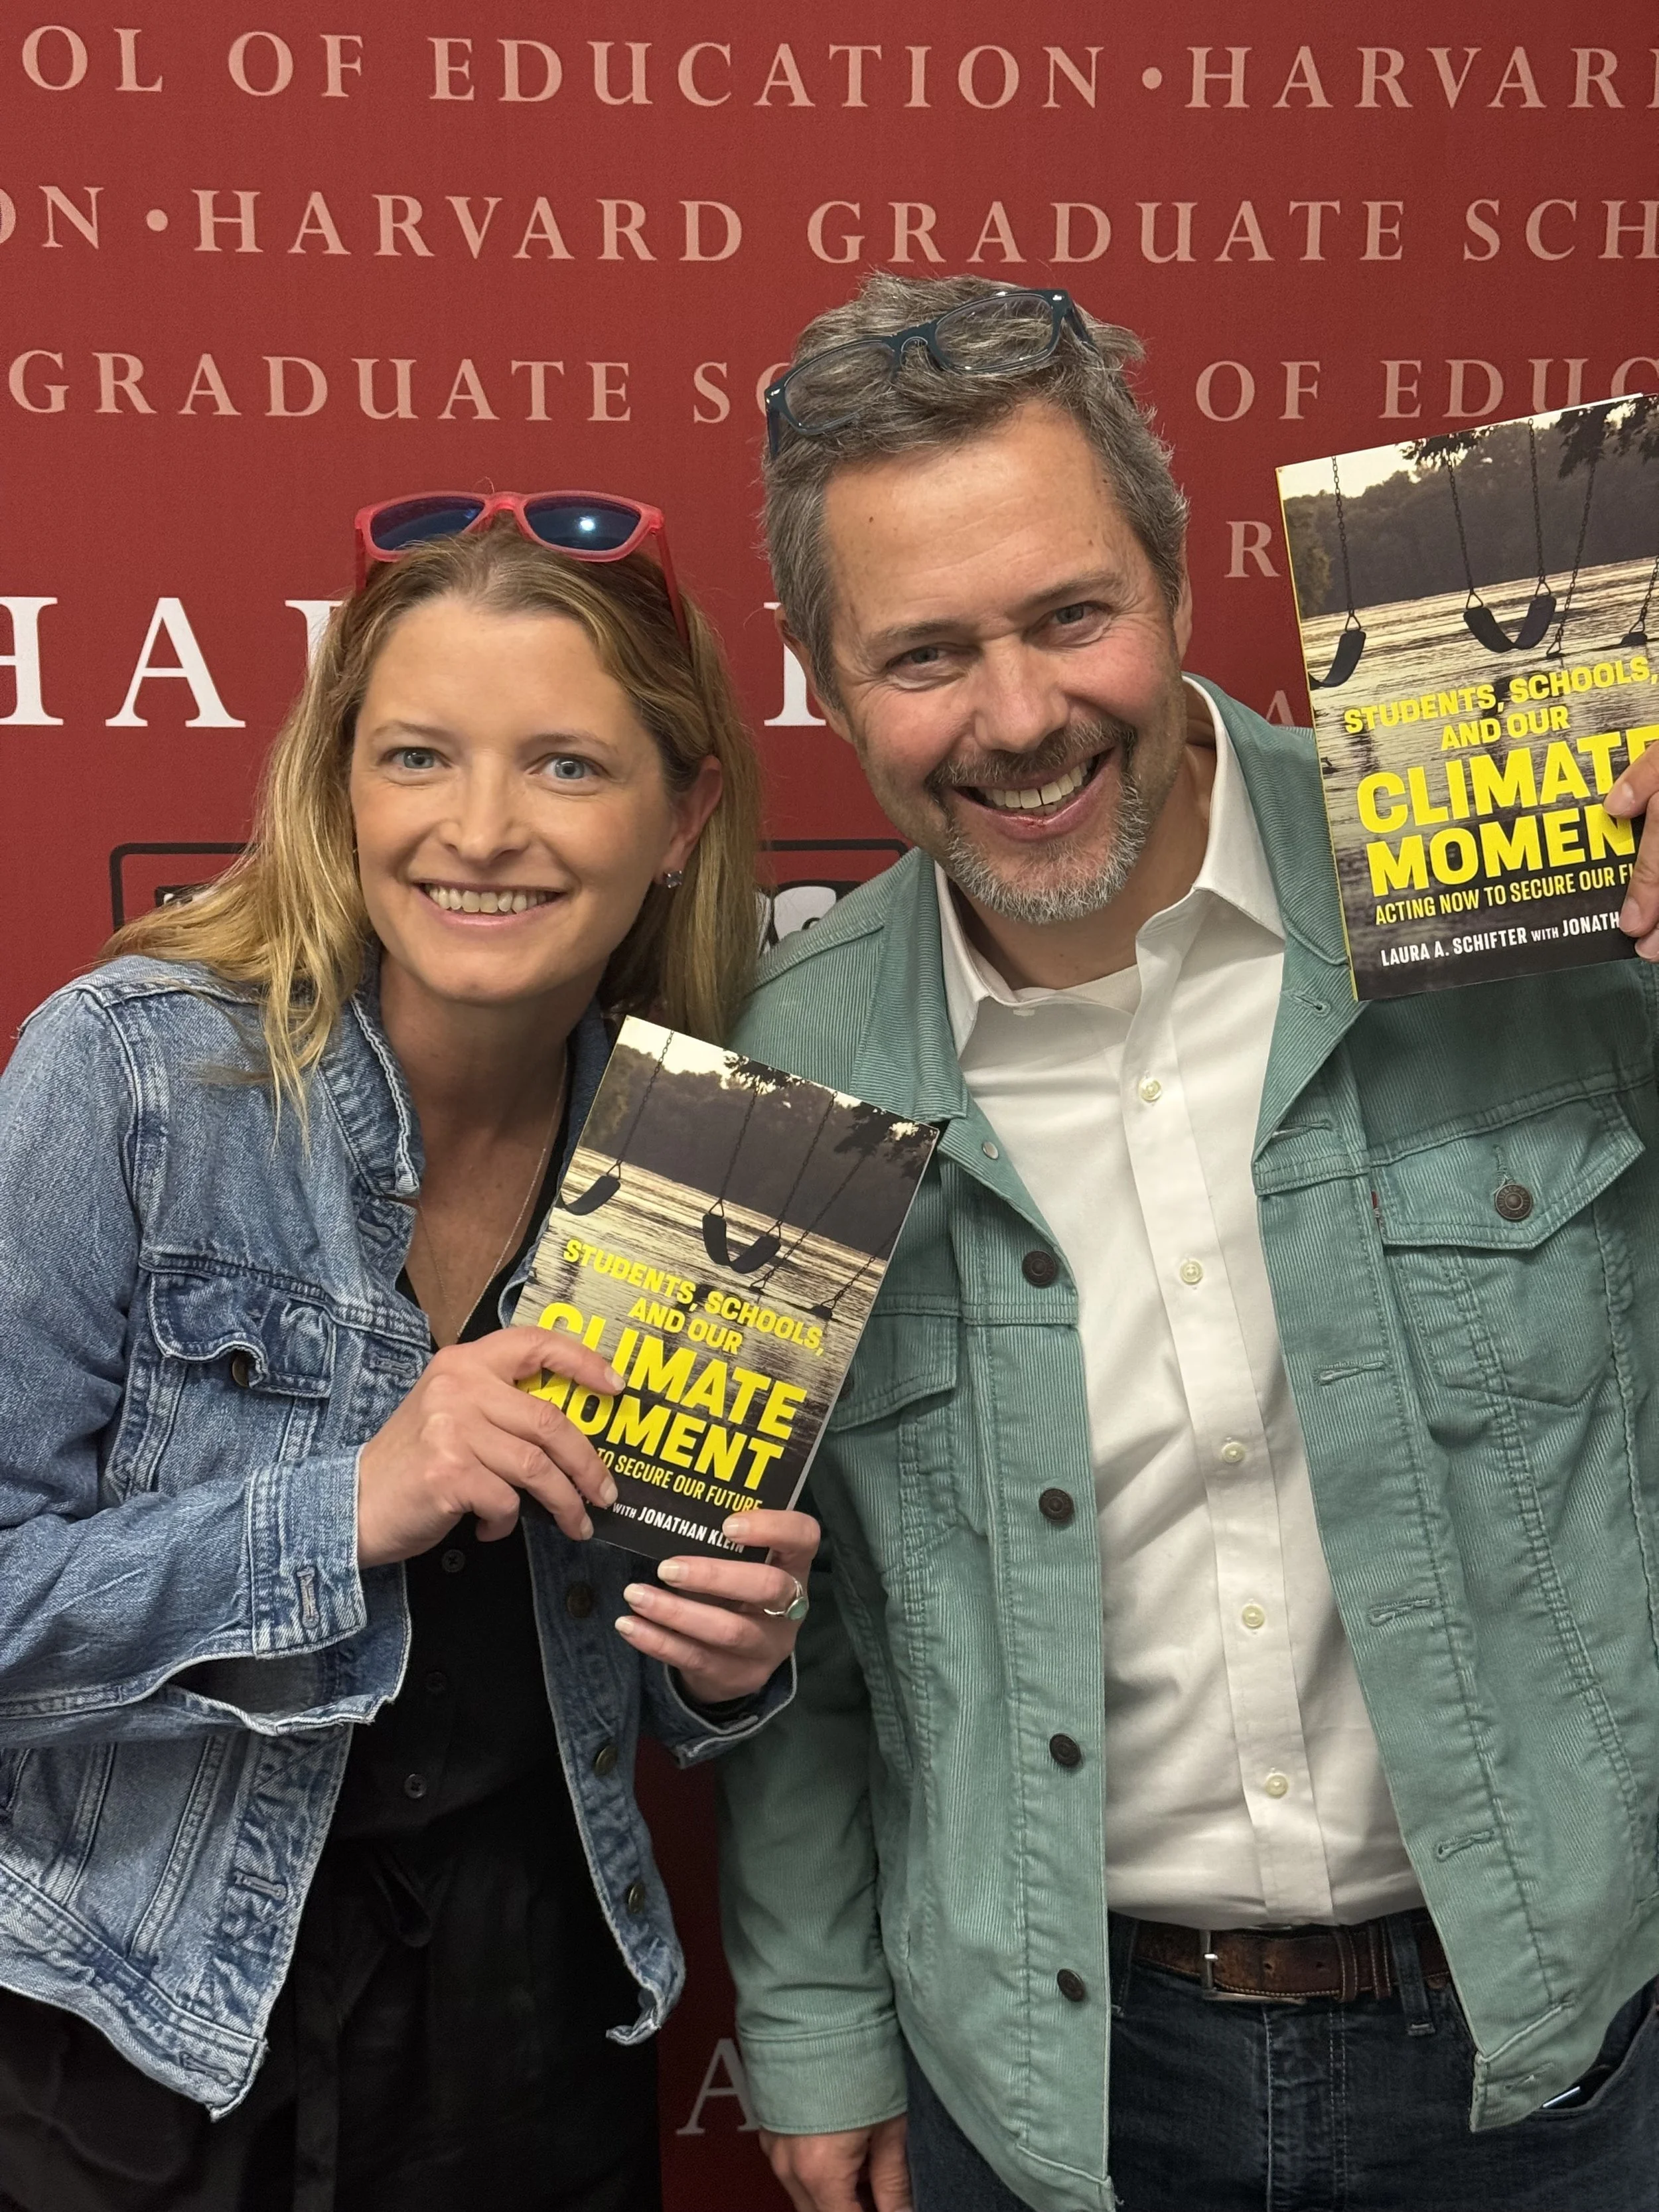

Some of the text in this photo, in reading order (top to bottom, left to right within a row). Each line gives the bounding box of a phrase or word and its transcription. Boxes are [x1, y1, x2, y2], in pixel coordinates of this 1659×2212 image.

[228, 31, 364, 98] OF
[428, 37, 1104, 110] EDUCATION
[1185, 46, 1659, 110] HARVAR
[192, 189, 742, 261] HARVARD
[808, 200, 1404, 264] GRADUATE
[9, 350, 631, 422] GRADUATE
[1196, 361, 1321, 422] OF
[1344, 656, 1659, 734] STUDENTS, SCHOOLS,
[1441, 705, 1571, 751] AND OUR
[1376, 897, 1436, 926] ACTING
[1439, 889, 1480, 915] NOW
[1484, 885, 1506, 907] TO
[1510, 873, 1575, 903] SECURE
[1579, 866, 1615, 892] OUR
[1380, 943, 1428, 967] LAURA
[1434, 940, 1449, 958] A.
[1453, 927, 1528, 956] SCHIFTER
[1531, 927, 1559, 942] WITH
[563, 1238, 824, 1357] STUDENTS, SCHOOLS,
[627, 1297, 743, 1355] AND OUR
[614, 1455, 674, 1490] SECURE
[673, 1475, 705, 1501] OUR
[613, 1502, 637, 1519] WITH
[637, 1506, 707, 1542] JONATHAN
